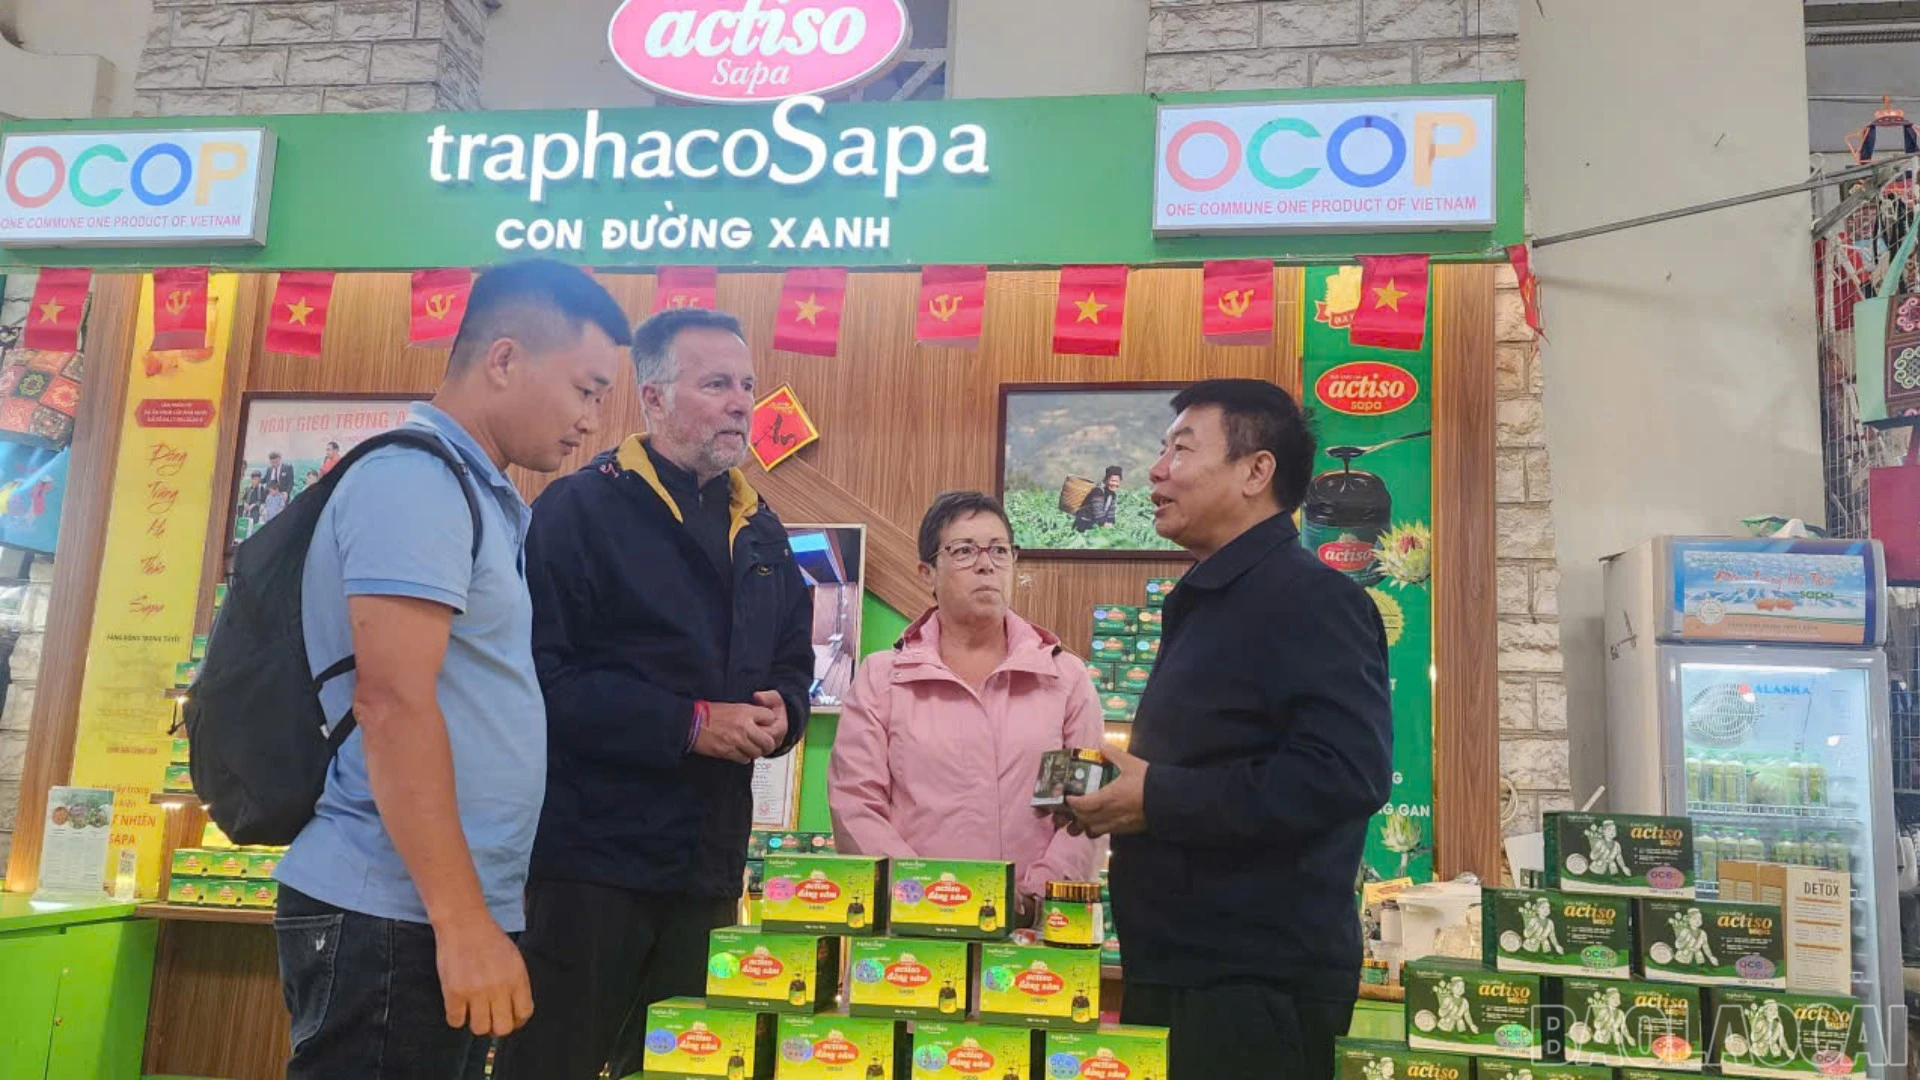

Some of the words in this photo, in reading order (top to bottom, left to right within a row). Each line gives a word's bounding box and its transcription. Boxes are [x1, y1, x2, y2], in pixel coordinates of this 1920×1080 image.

[645, 0, 867, 58] actiso
[712, 59, 791, 94] Sapa
[428, 95, 989, 202] traphacoSapa
[1165, 111, 1478, 192] OCOP
[5, 141, 248, 209] OCOP
[1166, 203, 1195, 216] ONE
[1199, 202, 1273, 215] COMMUNE
[1277, 201, 1308, 214] ONE
[1312, 199, 1381, 213] PRODUCT
[1387, 198, 1406, 212] OF
[1412, 197, 1477, 211] VIETNAM
[0, 217, 24, 229] ONE
[27, 216, 84, 229] COMMUNE
[87, 216, 111, 228] ONE
[114, 215, 169, 227] PRODUCT
[172, 215, 187, 227] OF
[191, 214, 241, 227] VIETNAM
[495, 218, 583, 250] CON
[602, 201, 753, 250] ĐƯỜNG
[769, 217, 890, 249] XANH
[1328, 373, 1405, 398] actiso
[1350, 401, 1382, 411] sapa
[297, 413, 330, 431] GIEO
[1325, 547, 1371, 561] actiso
[1754, 684, 1811, 695] ALASKA
[1399, 804, 1430, 817] GAN
[1630, 825, 1683, 840] actiso
[1804, 881, 1840, 897] DETOX
[1564, 903, 1616, 919] actiso
[1717, 912, 1773, 930] actiso
[1478, 982, 1531, 998] actiso
[1635, 993, 1688, 1008] actiso
[1794, 1006, 1850, 1022] actiso
[1407, 1063, 1459, 1080] actiso
